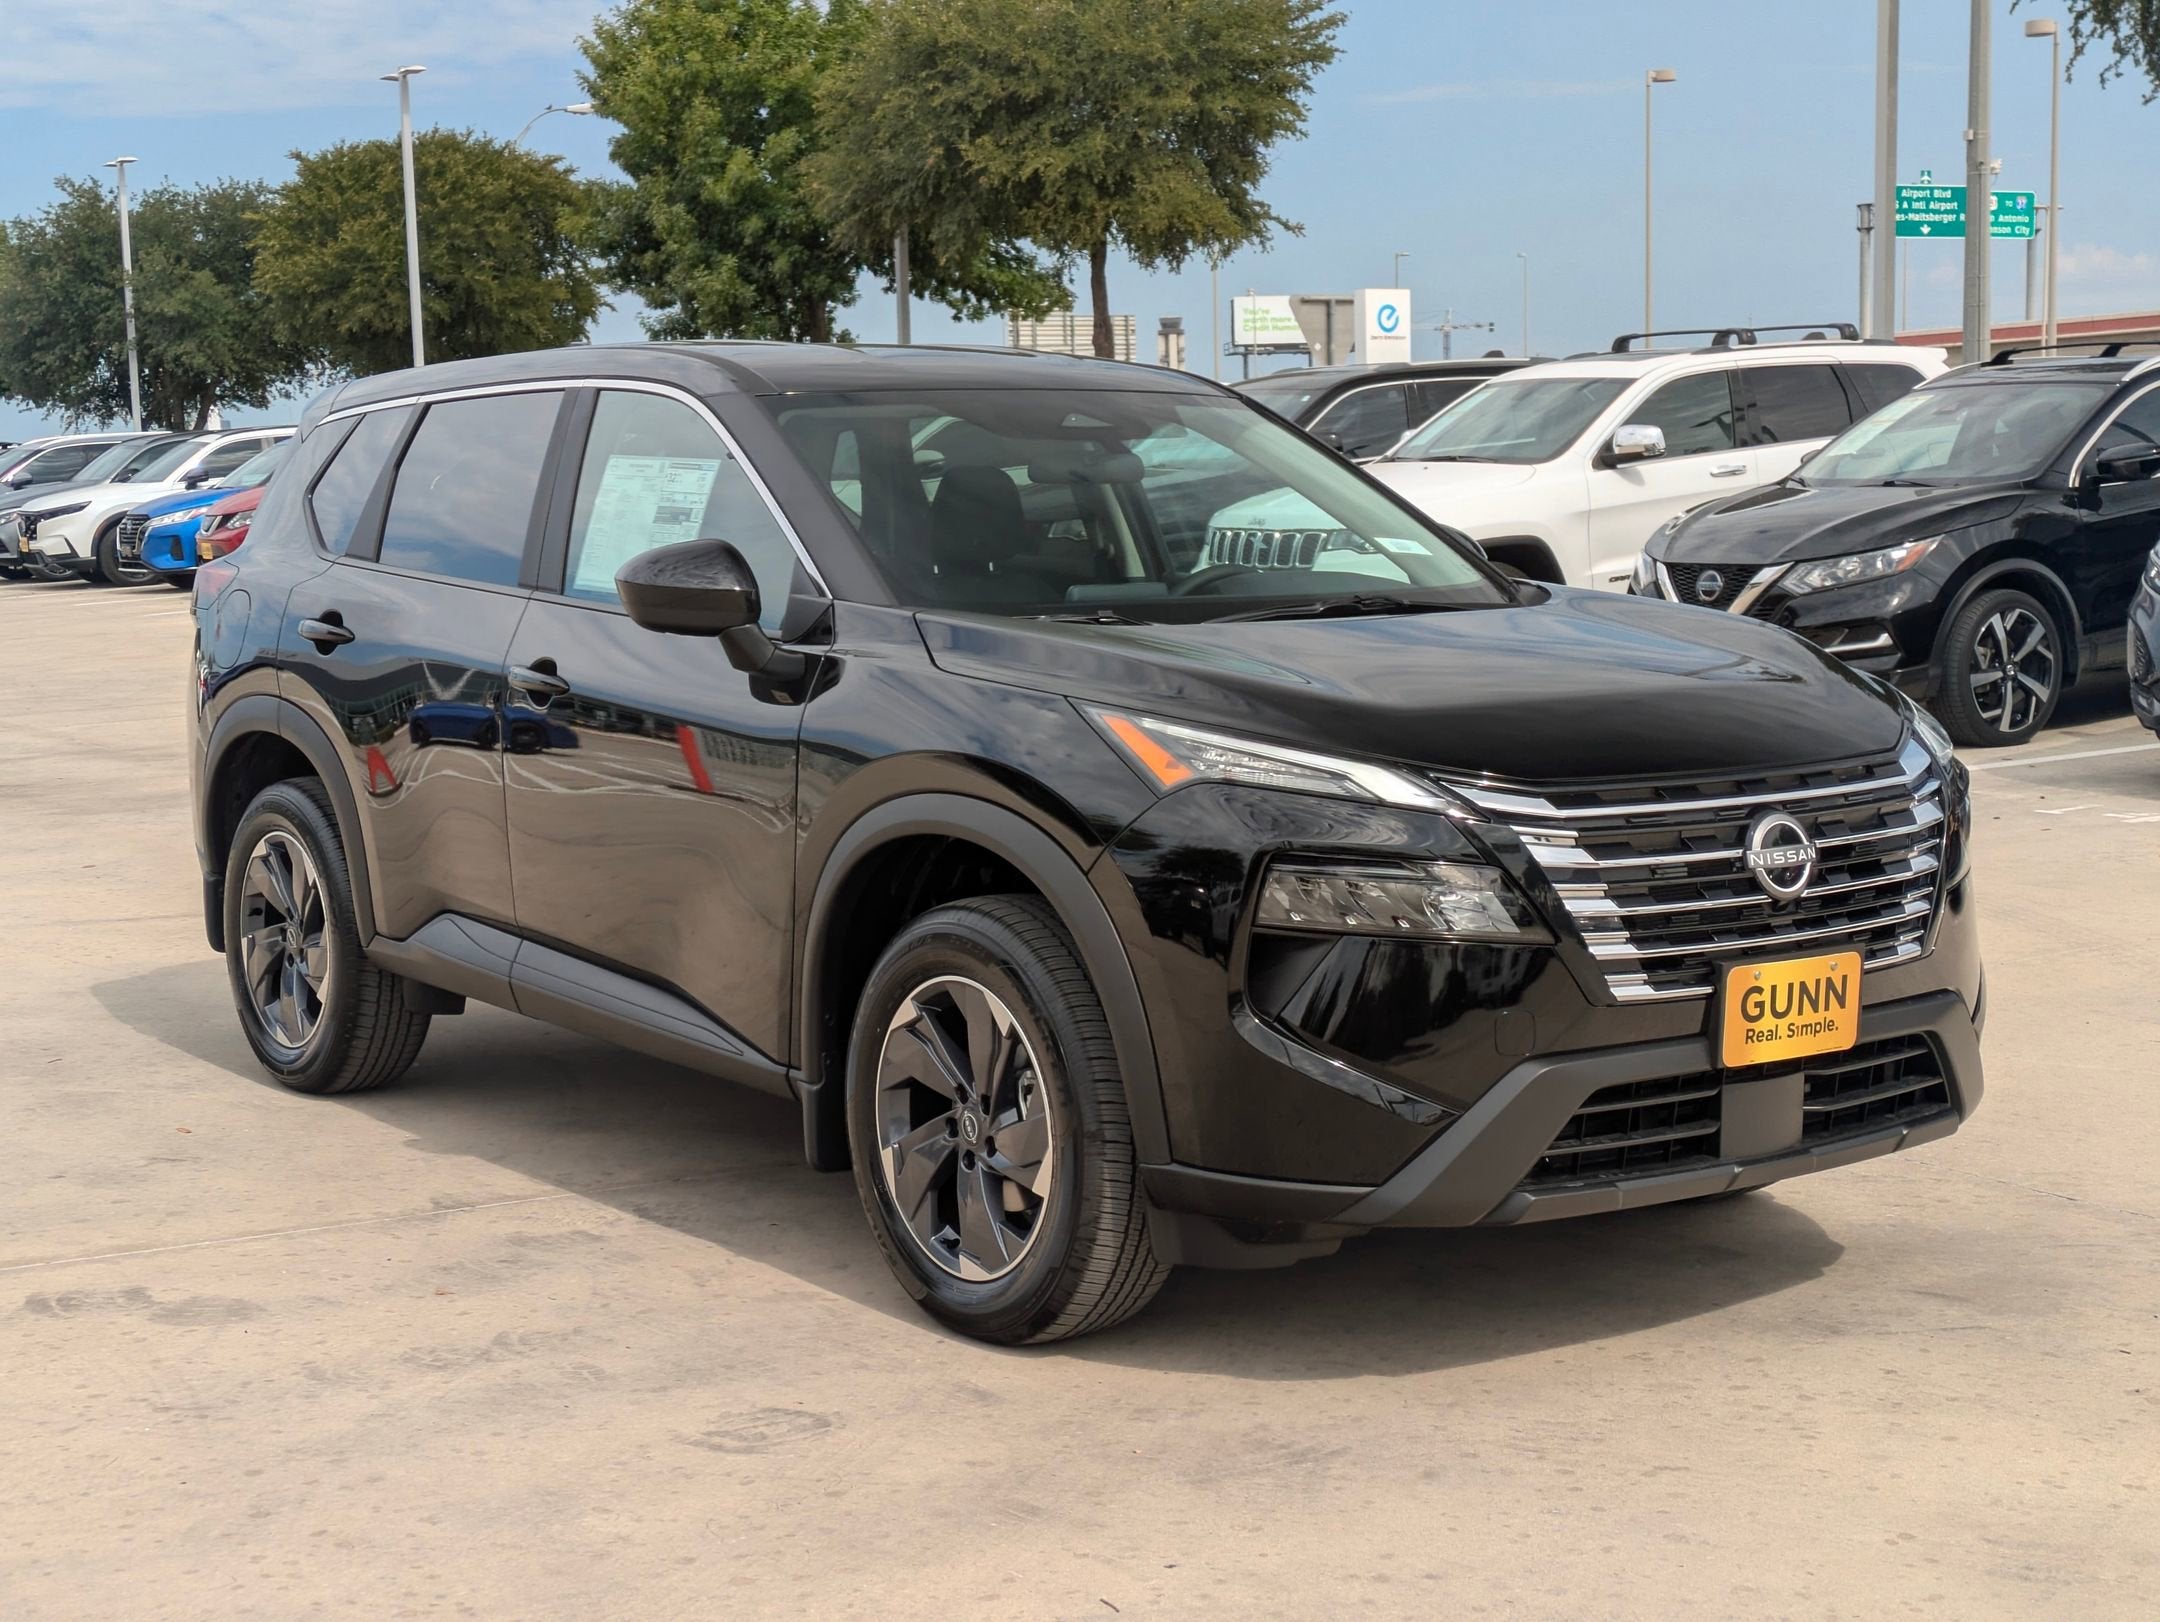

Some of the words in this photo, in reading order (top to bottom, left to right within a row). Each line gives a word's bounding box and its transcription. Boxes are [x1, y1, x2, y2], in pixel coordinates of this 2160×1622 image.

[1901, 188, 1931, 199] Airport
[1933, 189, 1951, 198] Blvd
[1902, 200, 1909, 209] A
[1912, 200, 1926, 209] Intl
[1929, 200, 1958, 211] Airport
[1895, 213, 1957, 223] es-Maltsberger
[1998, 214, 2030, 223] Antonio
[1990, 226, 2012, 234] nson
[2014, 225, 2031, 236] City
[1750, 846, 1816, 866] NISSAN
[1740, 974, 1848, 1024] GUNN
[1744, 1023, 1782, 1045] Real.
